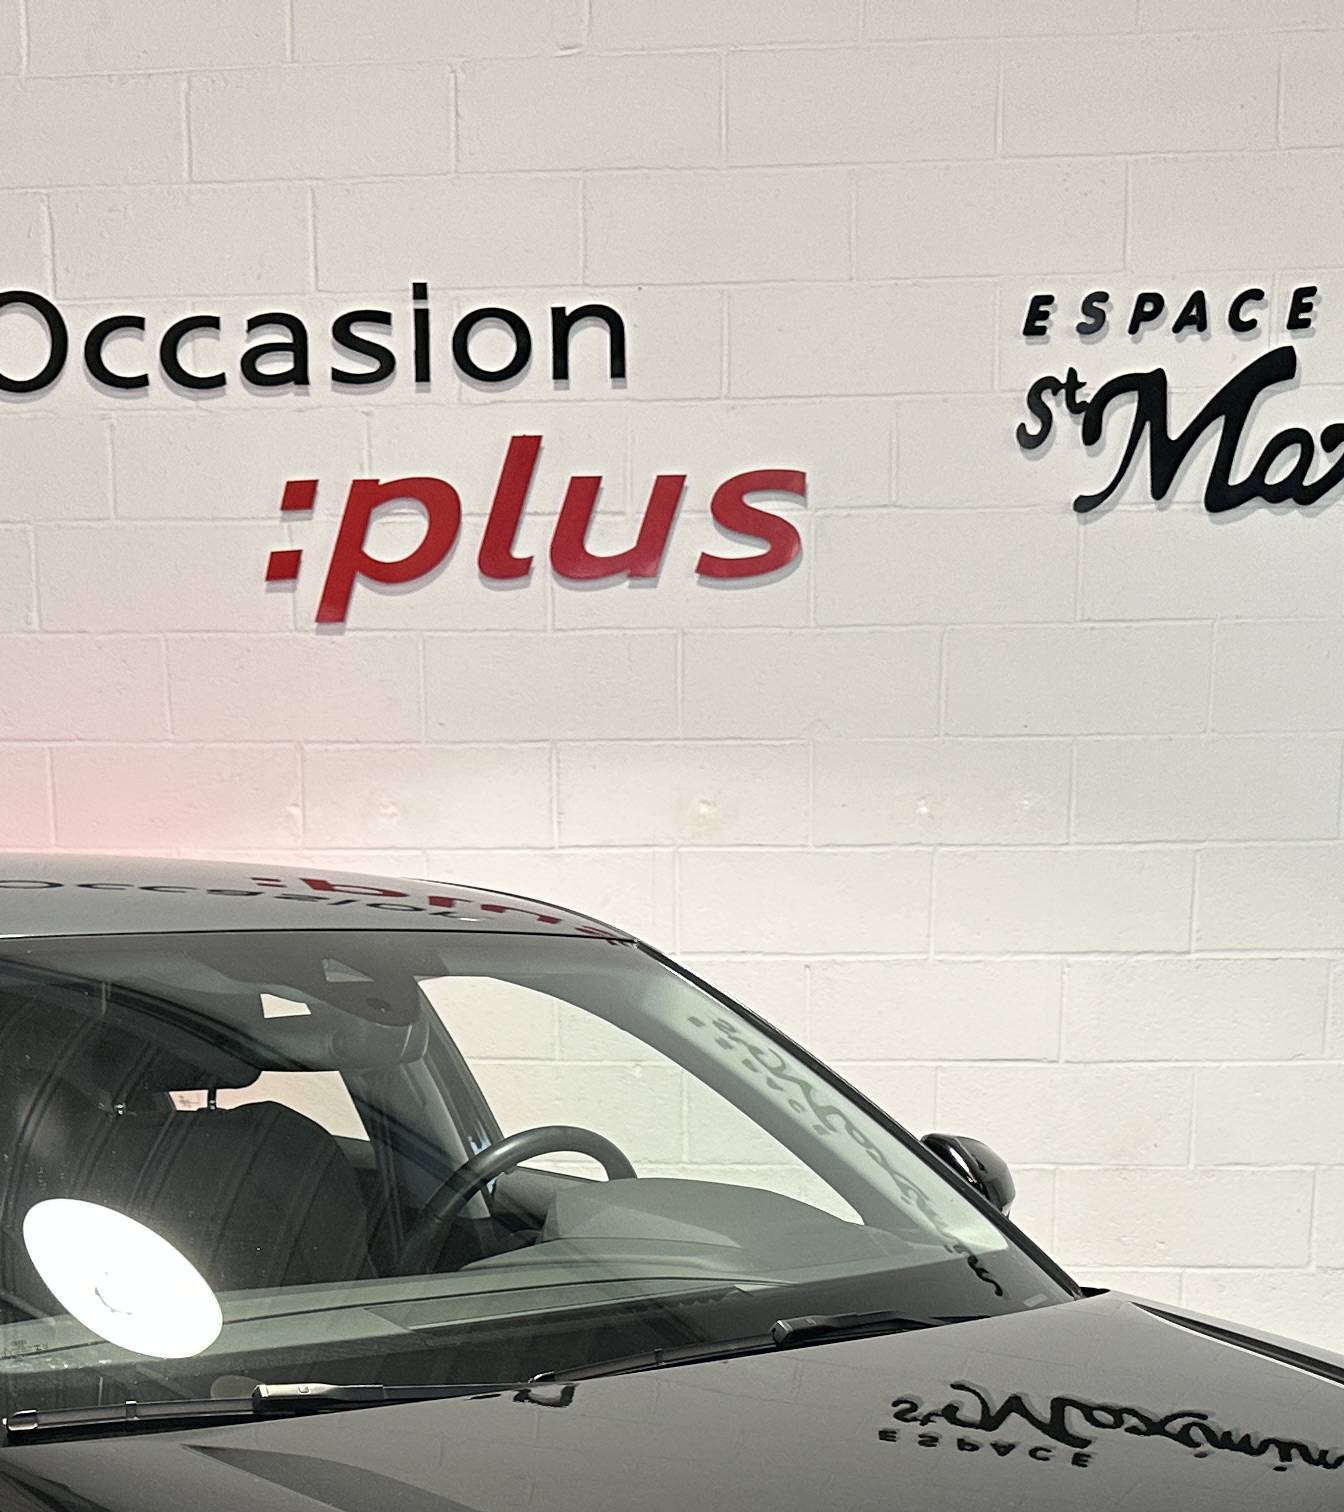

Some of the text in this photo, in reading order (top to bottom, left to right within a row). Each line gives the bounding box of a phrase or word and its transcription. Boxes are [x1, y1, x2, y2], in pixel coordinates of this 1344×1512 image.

[1021, 285, 1318, 336] ESPACE
[1016, 366, 1087, 450] St
[264, 434, 808, 624] :plus
